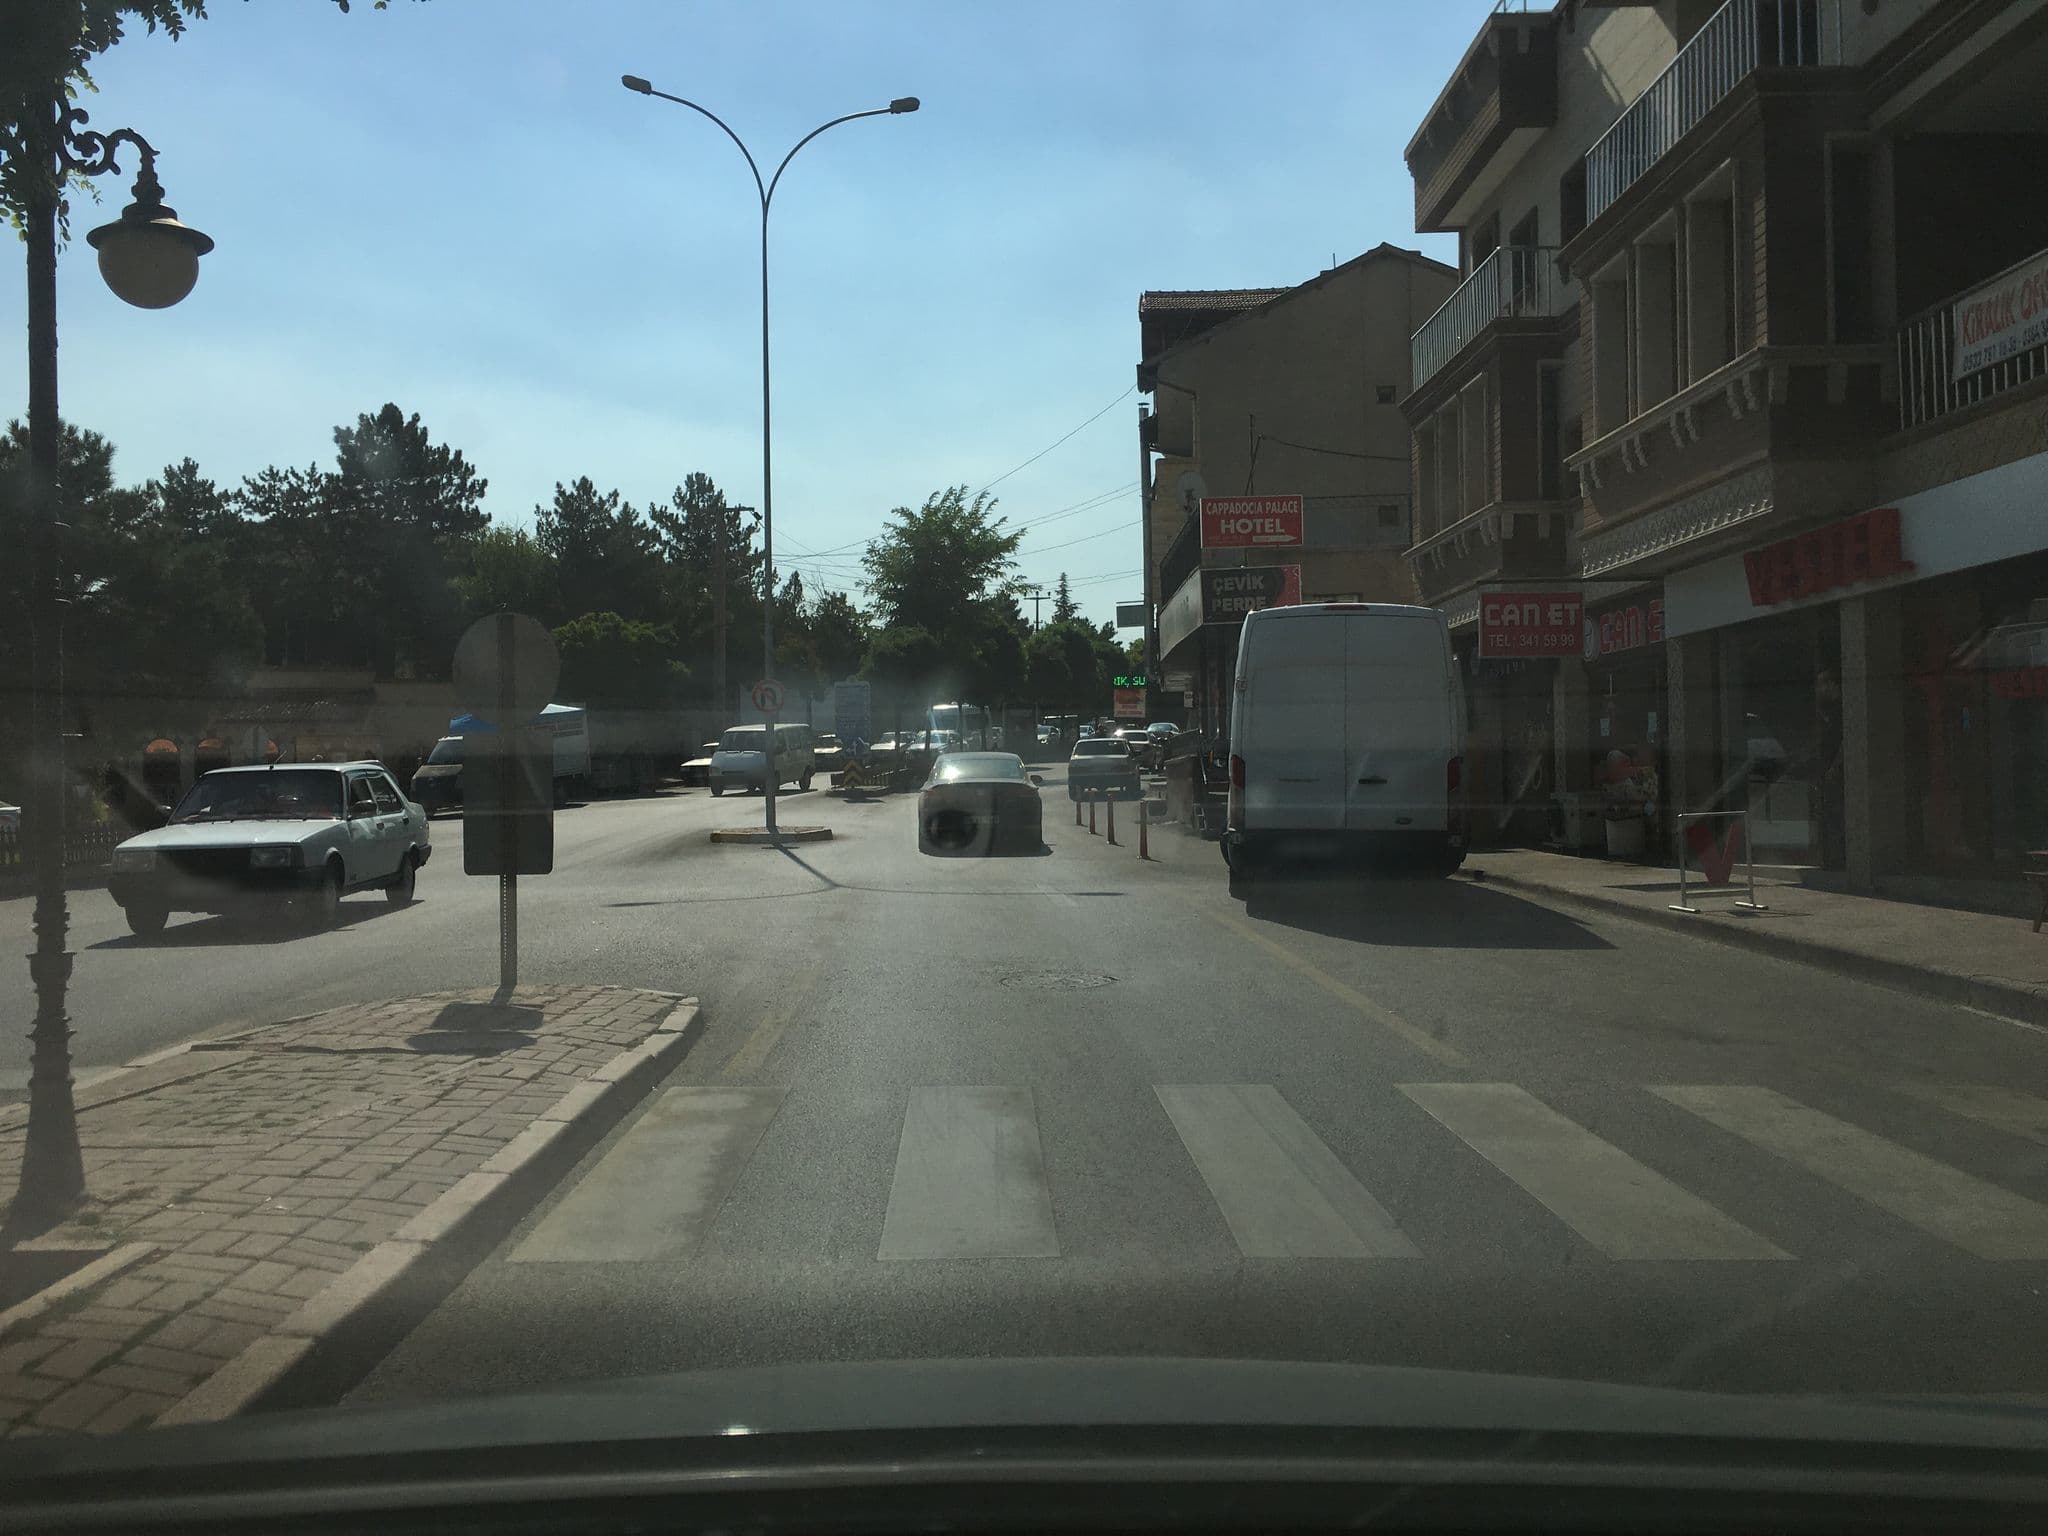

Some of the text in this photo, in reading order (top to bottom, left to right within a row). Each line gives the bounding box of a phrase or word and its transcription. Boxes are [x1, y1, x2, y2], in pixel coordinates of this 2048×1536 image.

[1206, 500, 1298, 516] CAPPADOCIA PALACE
[1220, 518, 1285, 534] HOTEL
[1214, 573, 1264, 595] ÇEVİK
[1211, 596, 1266, 612] PERDE
[1485, 603, 1580, 626] CAN ET
[1519, 634, 1538, 648] 341
[1132, 676, 1146, 686] SU
